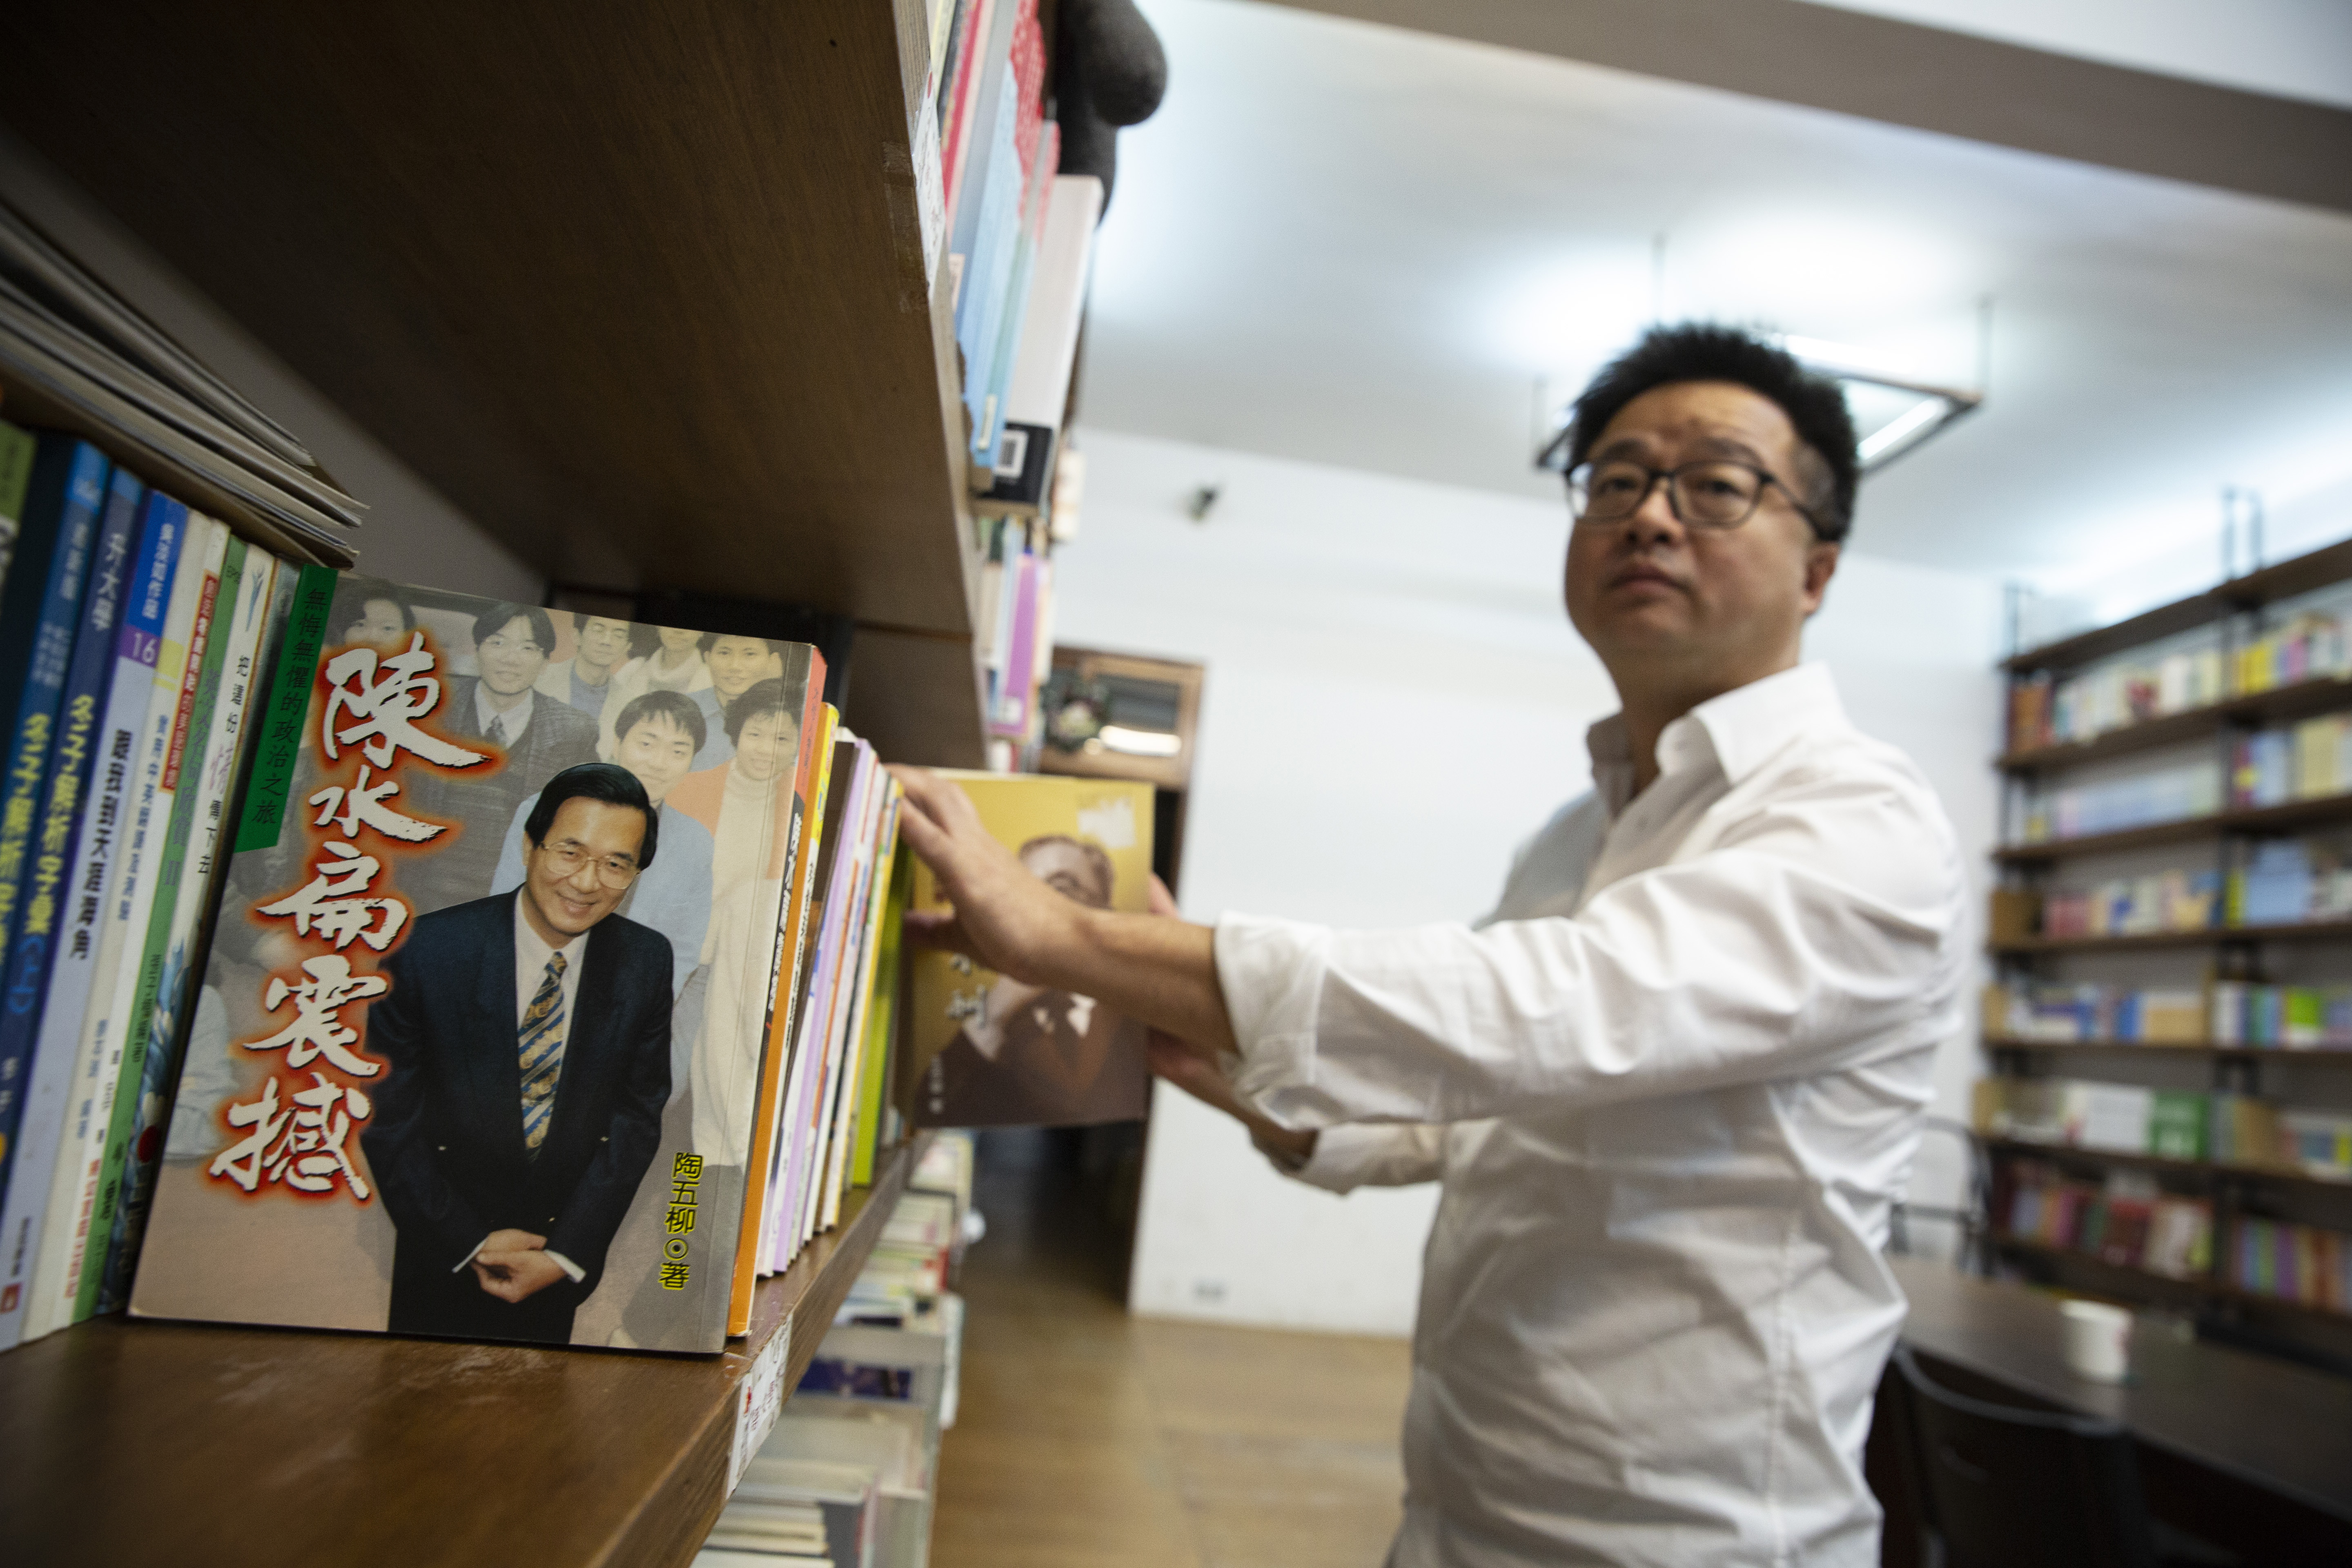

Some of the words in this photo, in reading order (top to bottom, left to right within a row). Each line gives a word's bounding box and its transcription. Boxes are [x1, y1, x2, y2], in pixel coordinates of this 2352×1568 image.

[133, 633, 156, 662] 16
[250, 587, 327, 825] 無悔無懼的政治之旅
[210, 631, 492, 1200] 陳水扁震撼
[658, 1152, 703, 1290] 陶五柳◎著
